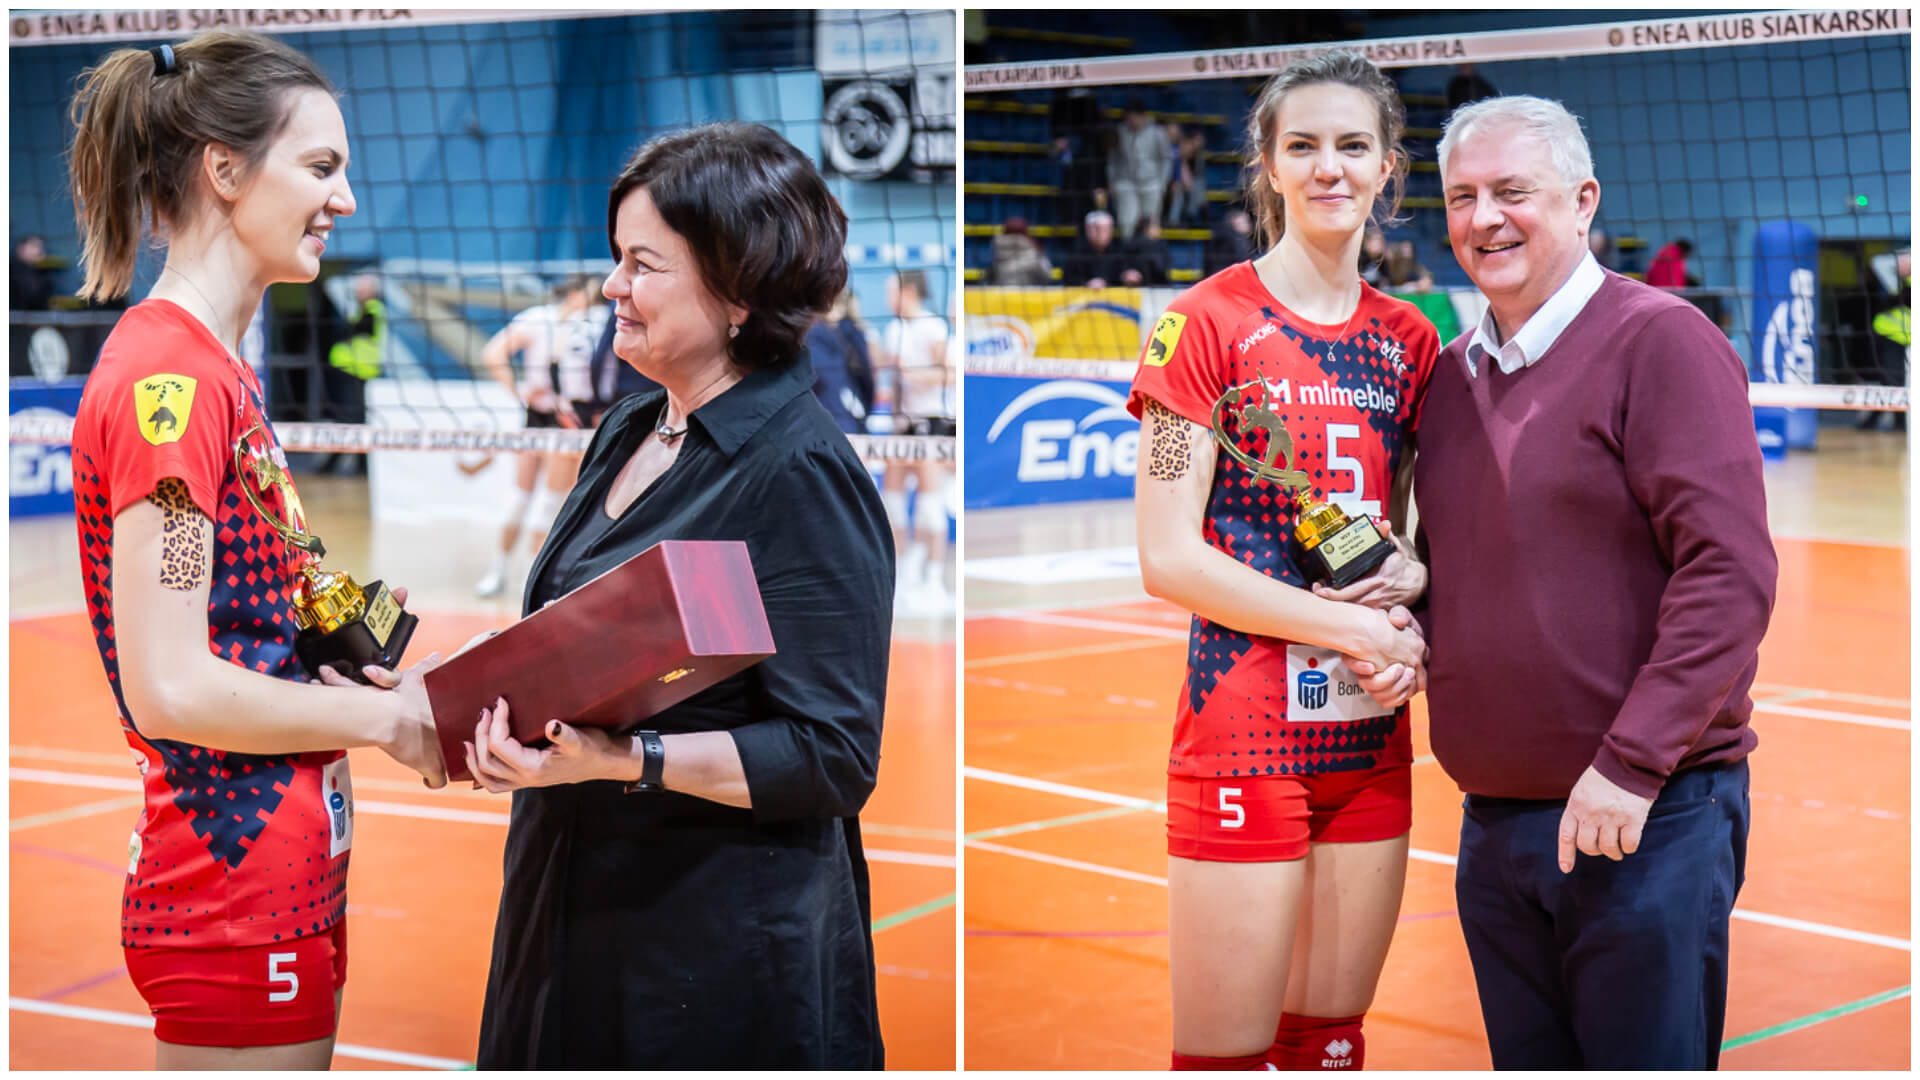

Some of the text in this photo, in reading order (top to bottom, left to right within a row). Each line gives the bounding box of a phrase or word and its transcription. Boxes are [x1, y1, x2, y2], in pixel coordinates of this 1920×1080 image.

[41, 13, 106, 36] ENEA
[1632, 23, 1691, 46] ENEA
[1698, 17, 1755, 41] KLUB
[1763, 9, 1899, 38] SIATKARSKI
[1213, 50, 1259, 72] ENEA
[1299, 379, 1396, 414] mlmeble
[1325, 423, 1365, 503] 5
[1218, 787, 1246, 828] 5
[268, 952, 299, 1003] 5
